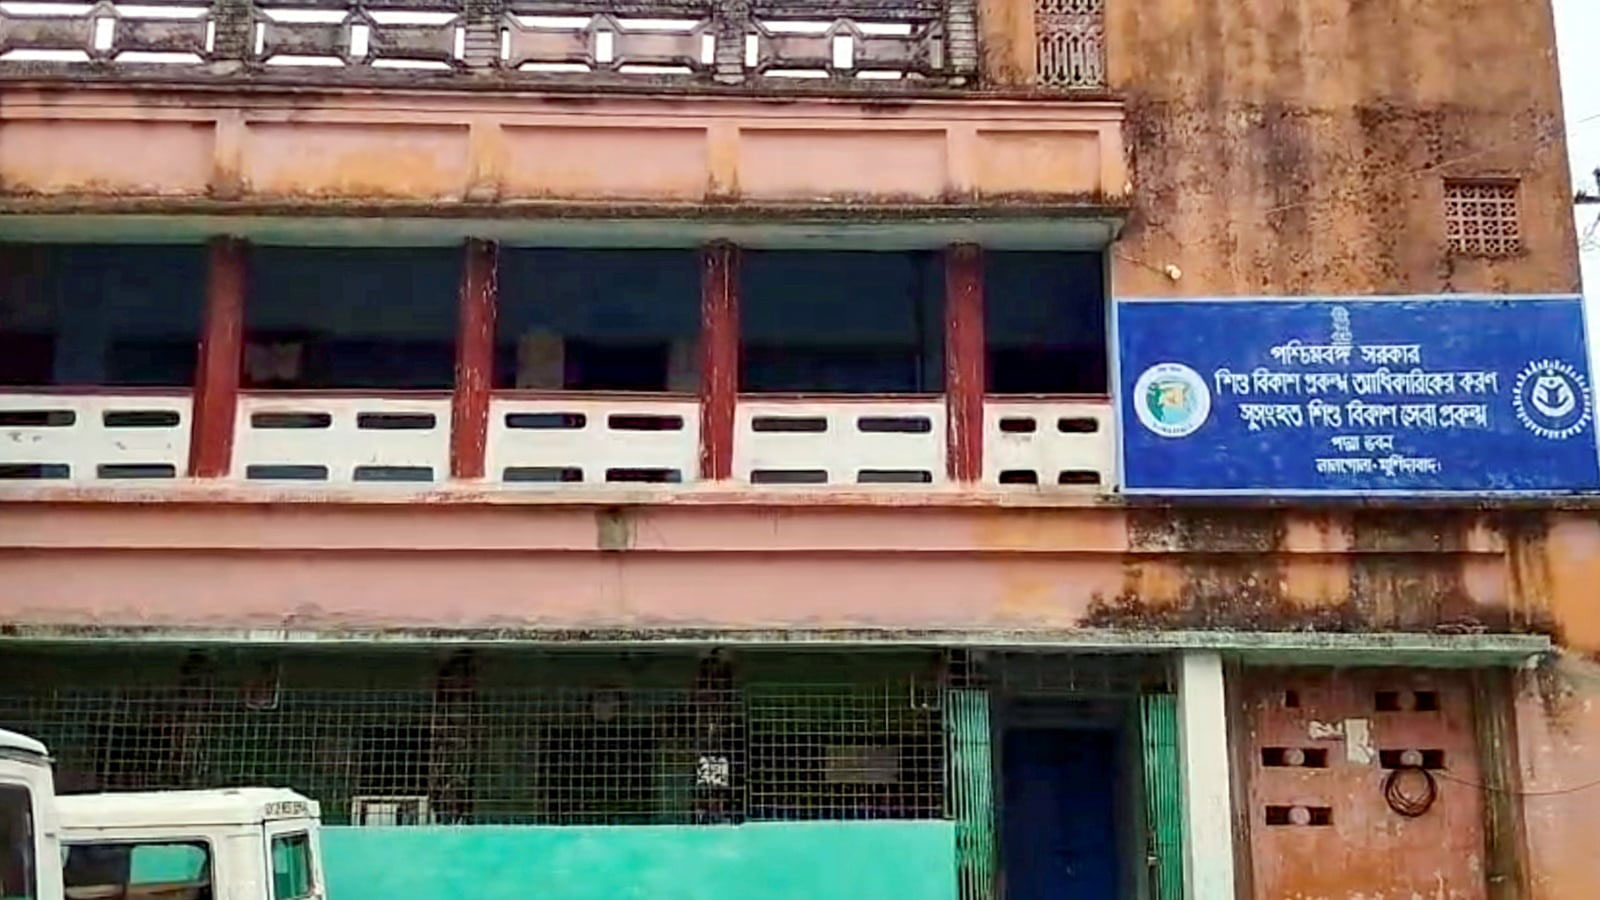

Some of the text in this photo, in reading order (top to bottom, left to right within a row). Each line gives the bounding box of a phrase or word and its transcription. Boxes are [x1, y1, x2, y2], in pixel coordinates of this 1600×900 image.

[1270, 338, 1420, 365] পশ্চিমবঙ্গ সরকার
[1214, 368, 1249, 395] শিশু
[1252, 367, 1301, 395] বিকাশ
[1352, 367, 1455, 395] আধিকারিকের
[1458, 371, 1498, 394] করণ
[1239, 403, 1303, 431] সুসংহত
[1307, 398, 1342, 428] শিশু
[1346, 400, 1396, 427] বিকাশ
[1400, 404, 1437, 428] সেবা
